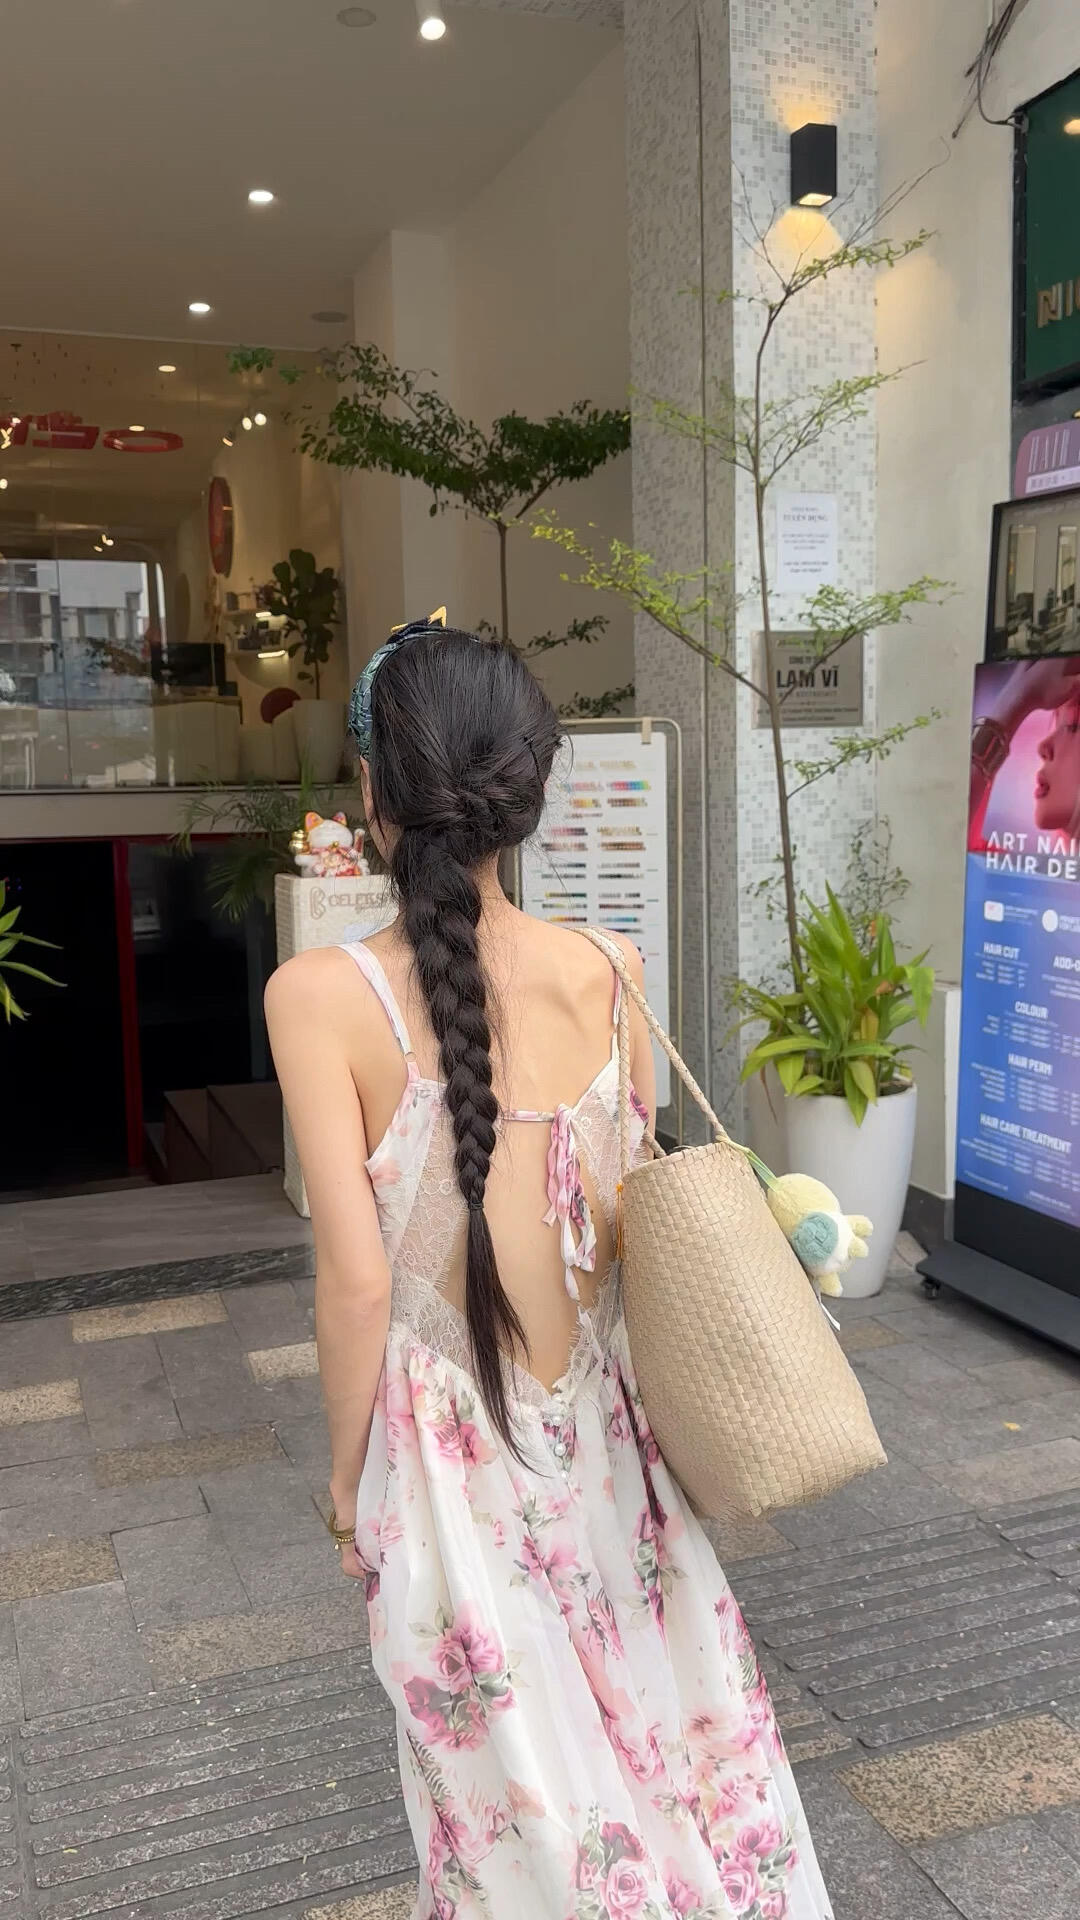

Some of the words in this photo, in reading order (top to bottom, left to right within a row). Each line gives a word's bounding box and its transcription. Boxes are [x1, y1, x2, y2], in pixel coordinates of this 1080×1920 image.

[986, 831, 1028, 852] ART
[1037, 836, 1080, 858] NAI
[986, 851, 1038, 875] HAIR
[983, 942, 1002, 957] HAIR
[1003, 945, 1020, 960] CUT
[1014, 1001, 1049, 1019] COLOUR
[1008, 1053, 1028, 1069] HAIR
[1028, 1059, 1053, 1075] PERM
[980, 1112, 999, 1129] HAIR
[999, 1119, 1021, 1137] CARE
[1021, 1126, 1072, 1153] TREATMENT
